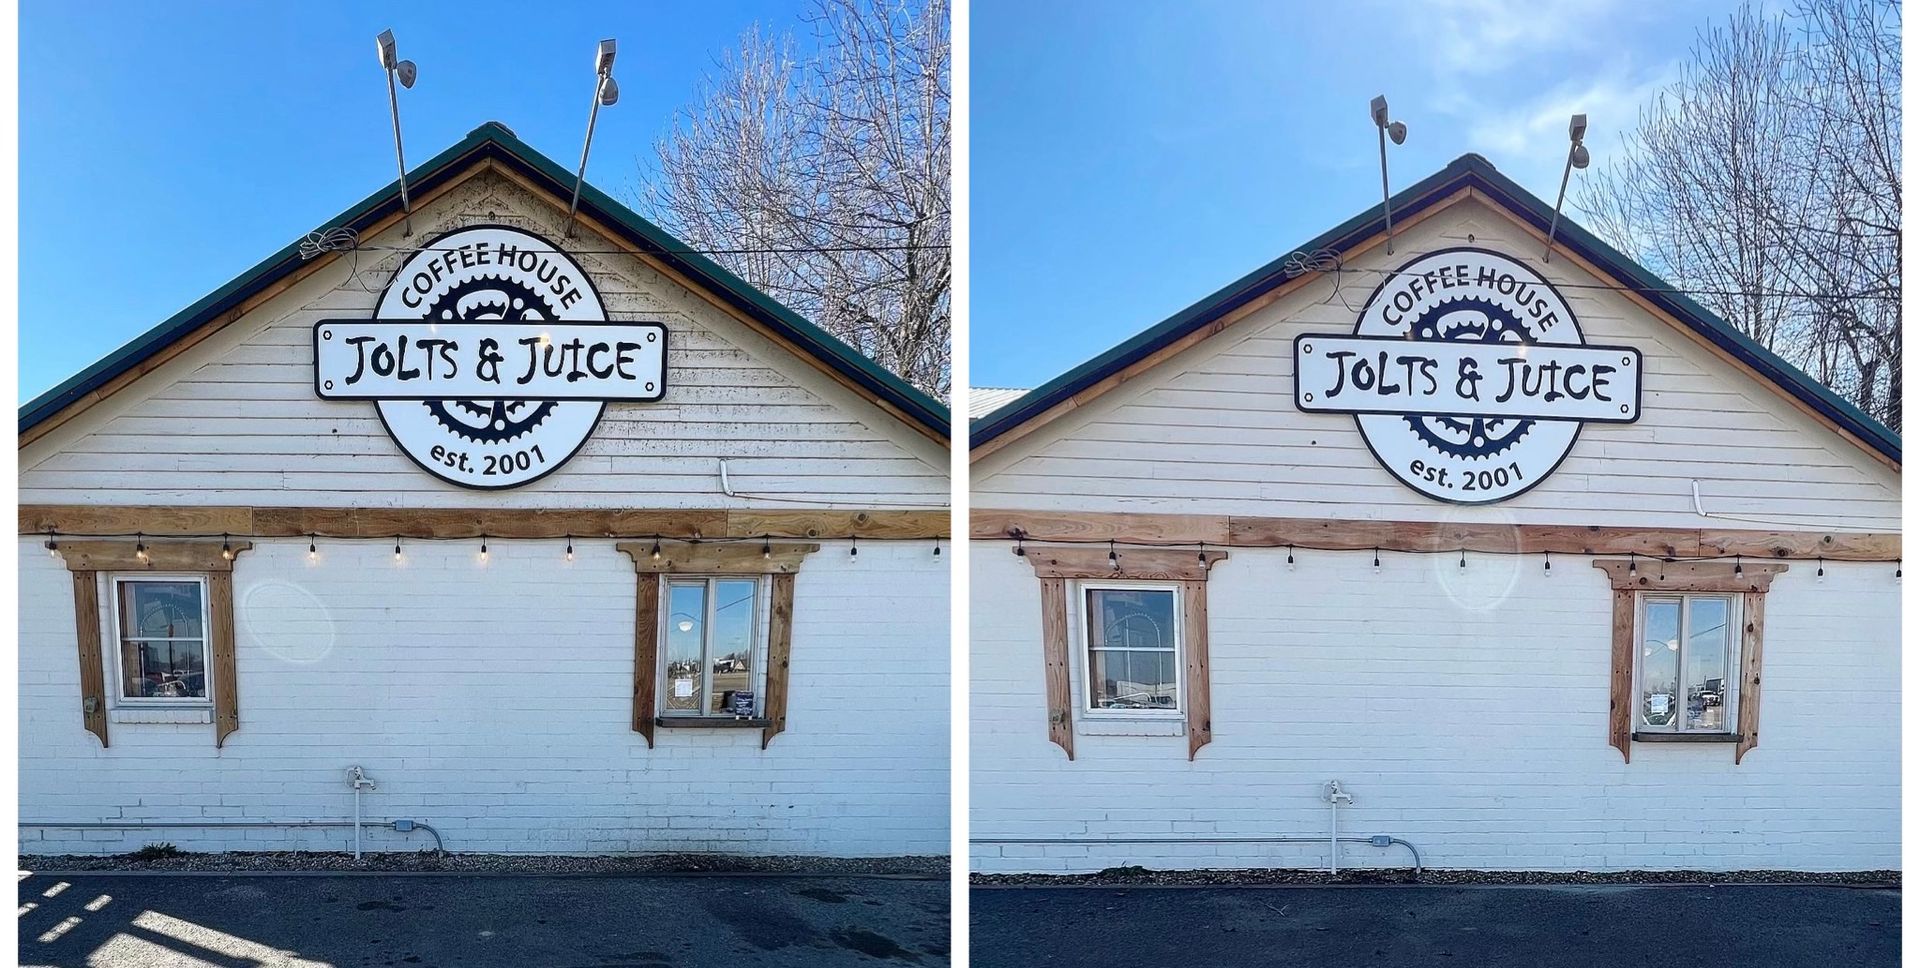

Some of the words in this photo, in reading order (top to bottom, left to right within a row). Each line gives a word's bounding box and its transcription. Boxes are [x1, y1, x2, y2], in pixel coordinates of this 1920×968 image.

[401, 242, 491, 309] COFFEE
[498, 243, 583, 311] HOUSE
[1381, 264, 1470, 326] COFFEE
[1477, 265, 1559, 333] HOUSE
[345, 334, 459, 386] JOLTS
[476, 337, 505, 385] &
[517, 336, 642, 385] JUICE
[1325, 350, 1438, 399] JOLTS
[1455, 357, 1484, 402] &
[1495, 357, 1617, 403] JUICE
[430, 444, 475, 474] est.
[482, 444, 545, 476] 2001
[1409, 458, 1453, 489] est.
[1461, 461, 1524, 491] 2001
